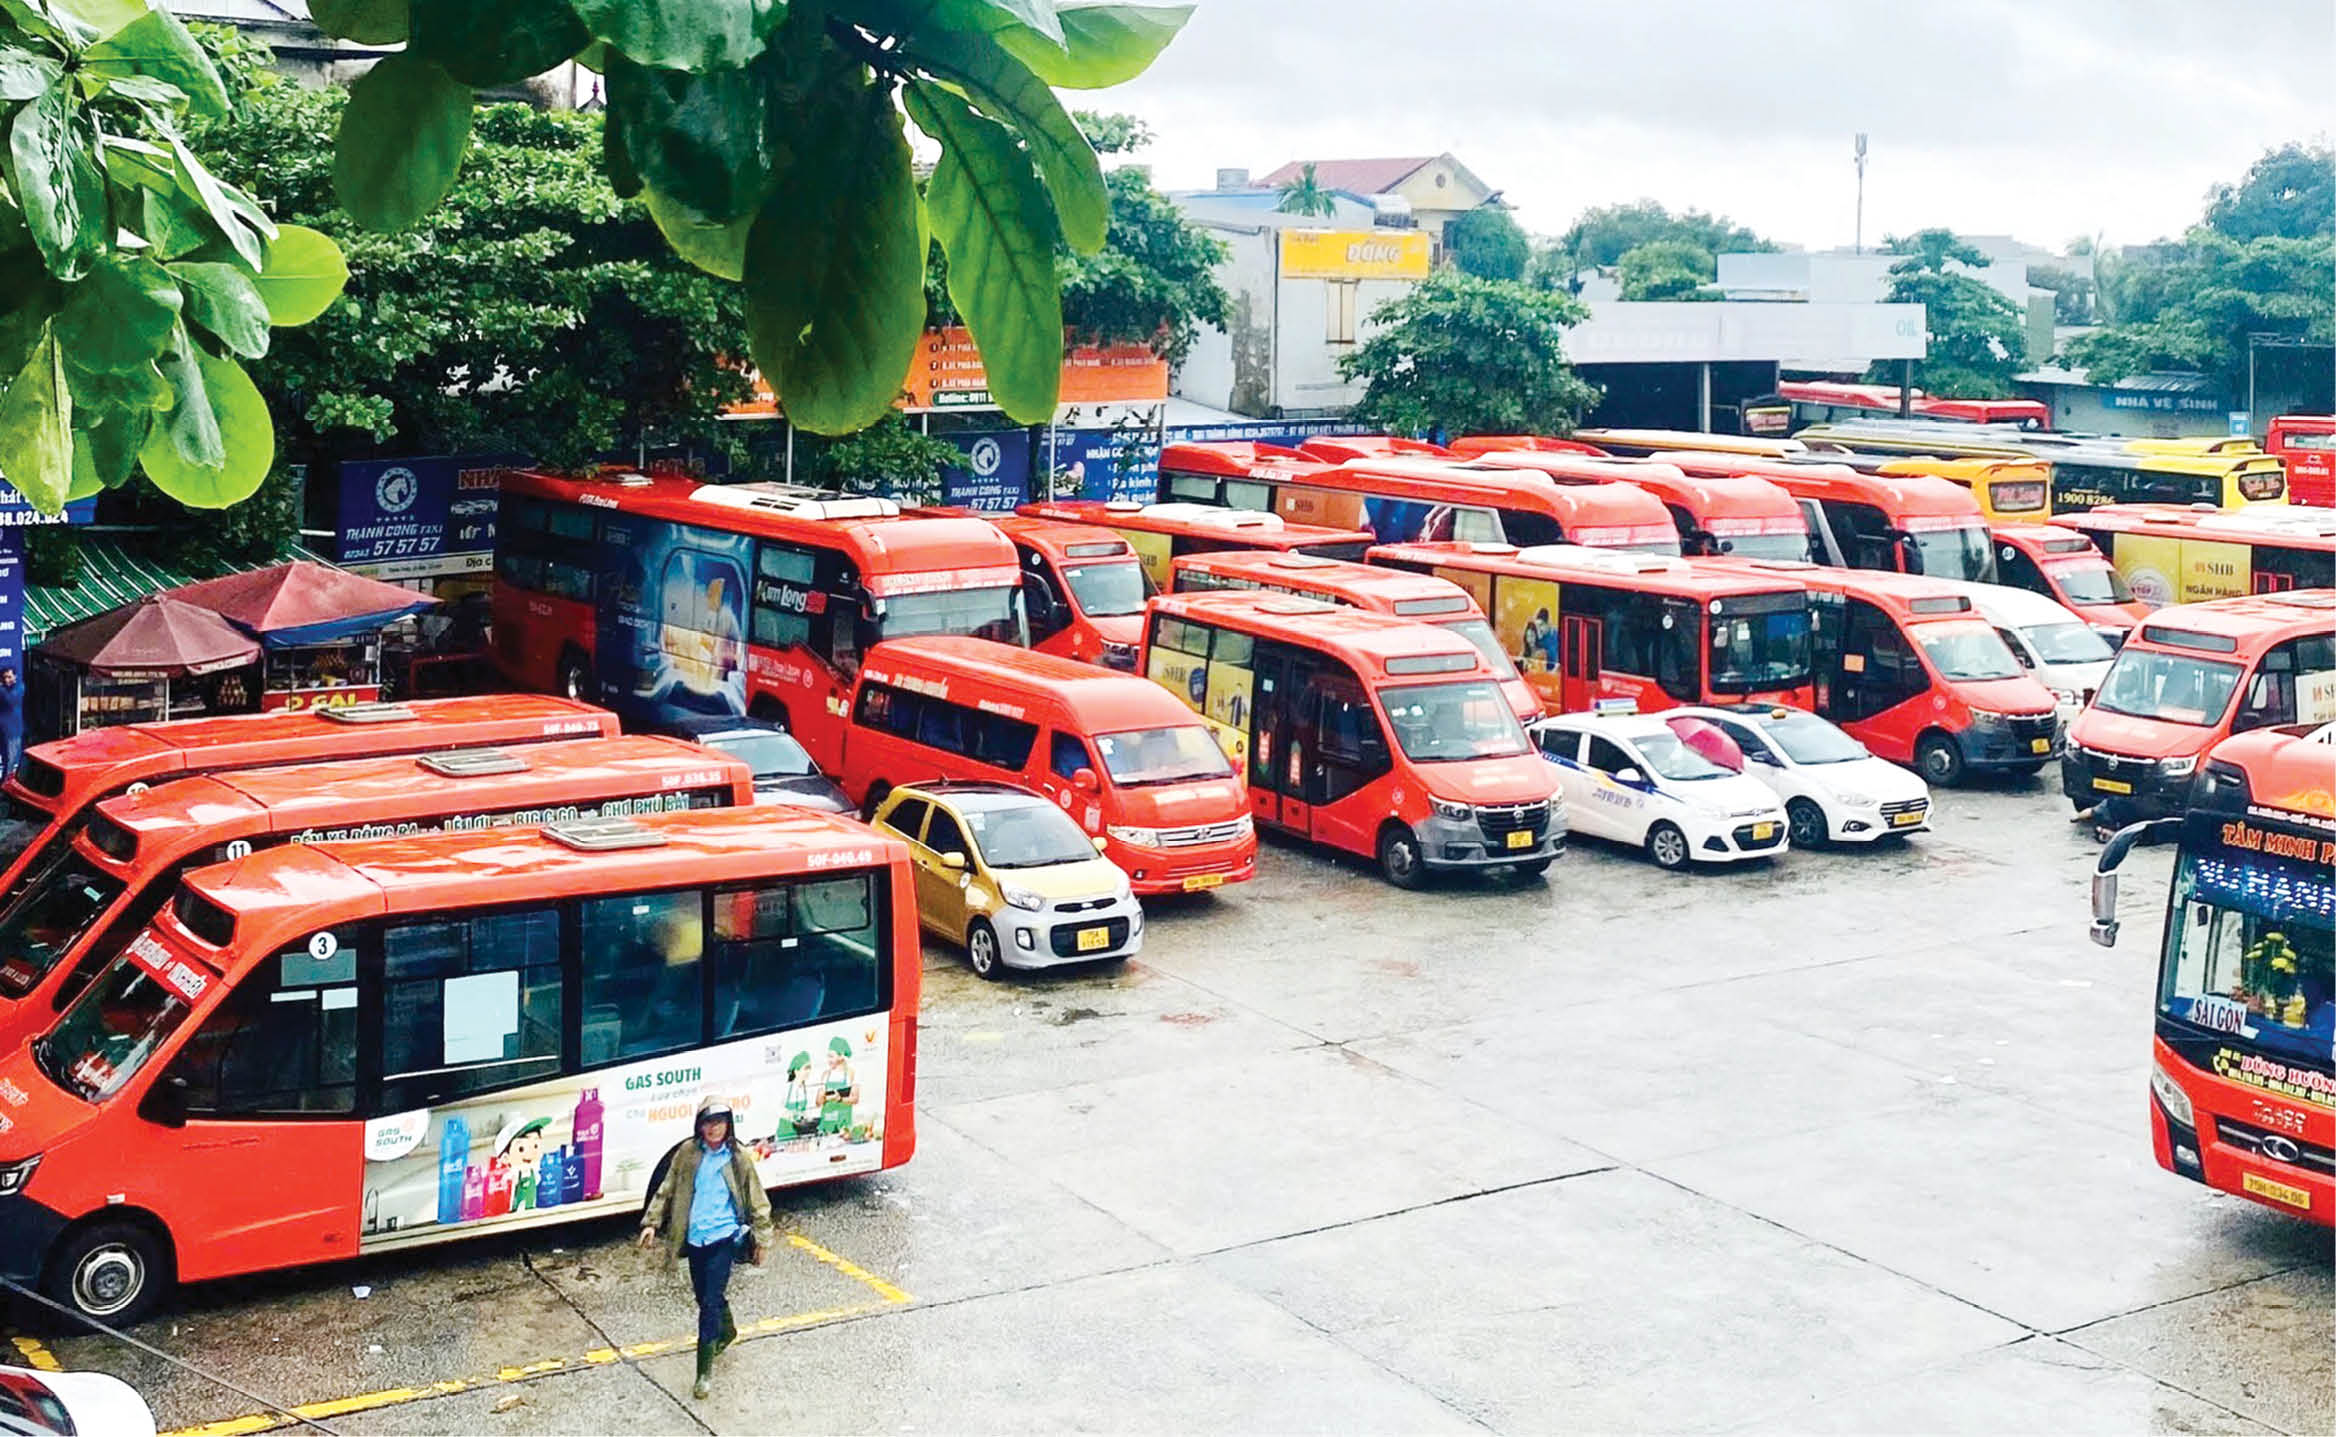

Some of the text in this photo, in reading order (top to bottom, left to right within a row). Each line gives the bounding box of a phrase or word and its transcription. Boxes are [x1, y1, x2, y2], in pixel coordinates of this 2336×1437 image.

[987, 497, 1001, 510] 57
[1002, 496, 1018, 509] 57
[373, 540, 395, 556] 57
[396, 538, 417, 554] 57
[418, 536, 440, 552] 57
[633, 794, 664, 814] PHÚ
[2264, 832, 2317, 861] MINH
[625, 1067, 702, 1091] GAS SOUTH
[2287, 1067, 2336, 1095] HƯỜN
[376, 1135, 413, 1147] SOUTH
[378, 1127, 400, 1138] GAS
